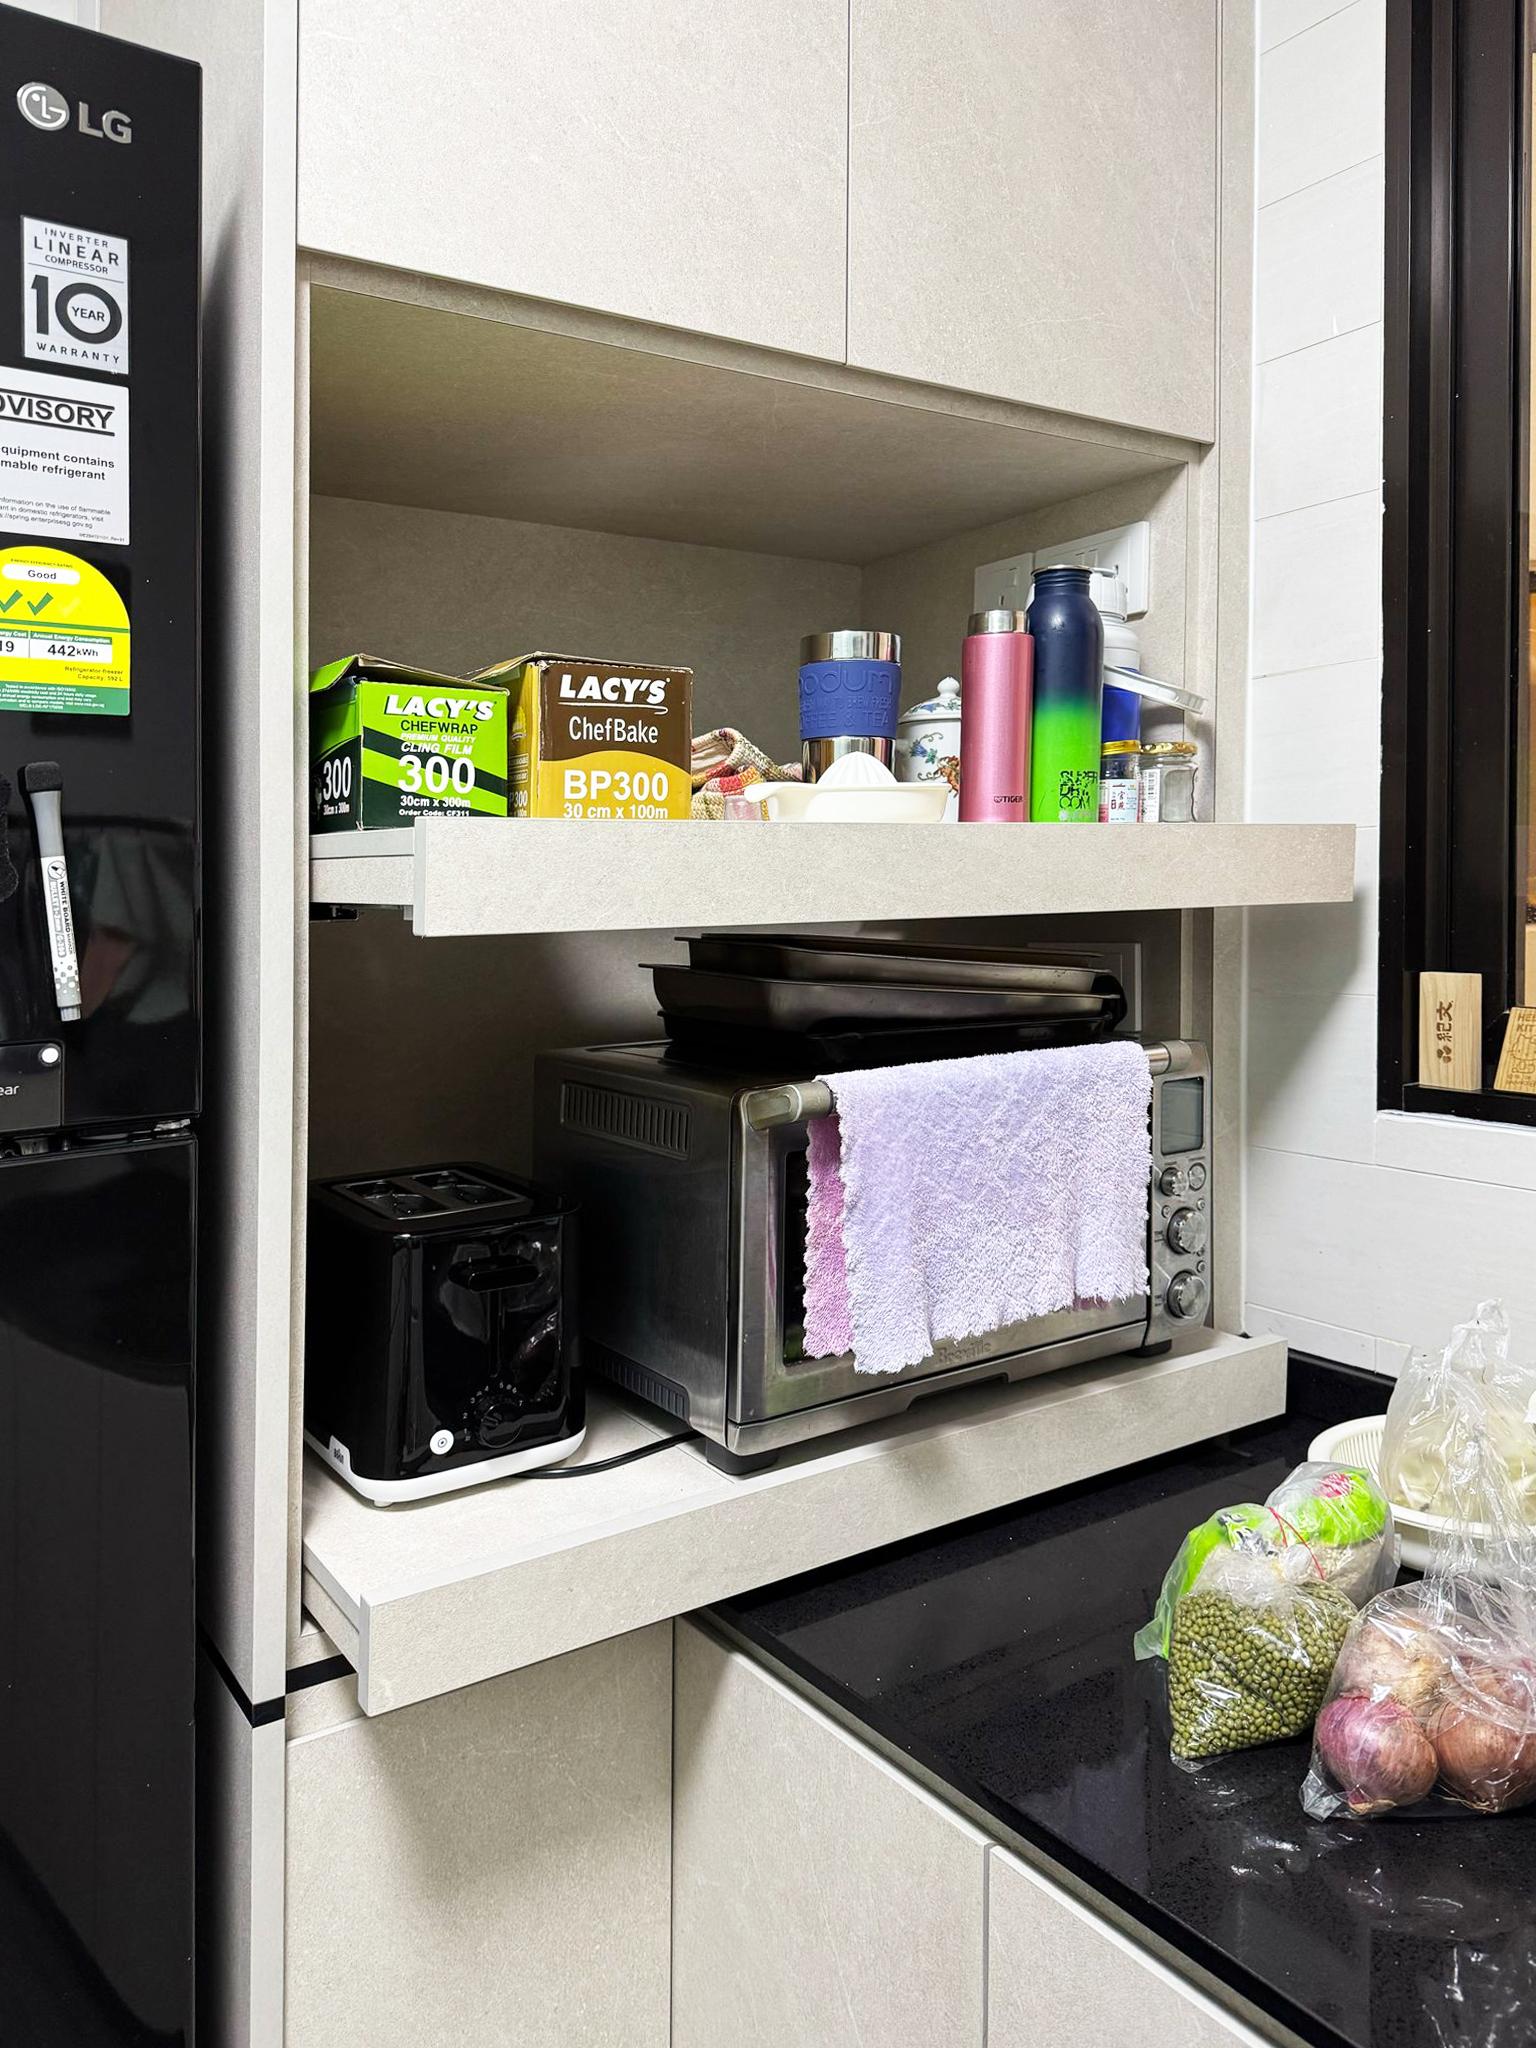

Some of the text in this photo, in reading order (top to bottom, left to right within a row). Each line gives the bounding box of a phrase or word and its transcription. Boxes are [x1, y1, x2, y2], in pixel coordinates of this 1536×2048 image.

[79, 101, 132, 144] LG
[44, 227, 109, 248] INVERTER
[34, 236, 119, 266] LINEAR
[44, 254, 109, 274] COMPRESSOR
[31, 274, 123, 345] 10
[71, 306, 106, 322] YEAR
[36, 342, 120, 364] WARRANTY
[63, 454, 115, 469] contains
[42, 465, 106, 481] refrigerant
[27, 569, 57, 580] Good
[559, 674, 667, 705] LACY'S
[799, 665, 893, 696] odum
[384, 694, 495, 721] LACY'S
[400, 719, 478, 735] CHEFWRAP
[401, 732, 476, 743] PREMIUM QUALITY
[569, 716, 659, 744] ChefBake
[401, 741, 473, 755] CLING FILM
[323, 756, 352, 801] 300
[398, 754, 475, 794] 300
[563, 769, 669, 801] BP300
[400, 795, 471, 808] 30cm x 300m
[563, 802, 669, 819] 30 cm x 100m
[422, 809, 445, 817] Code:
[59, 881, 68, 904] WHITE
[62, 907, 71, 933] BOARD
[1436, 1001, 1454, 1042] 紀文
